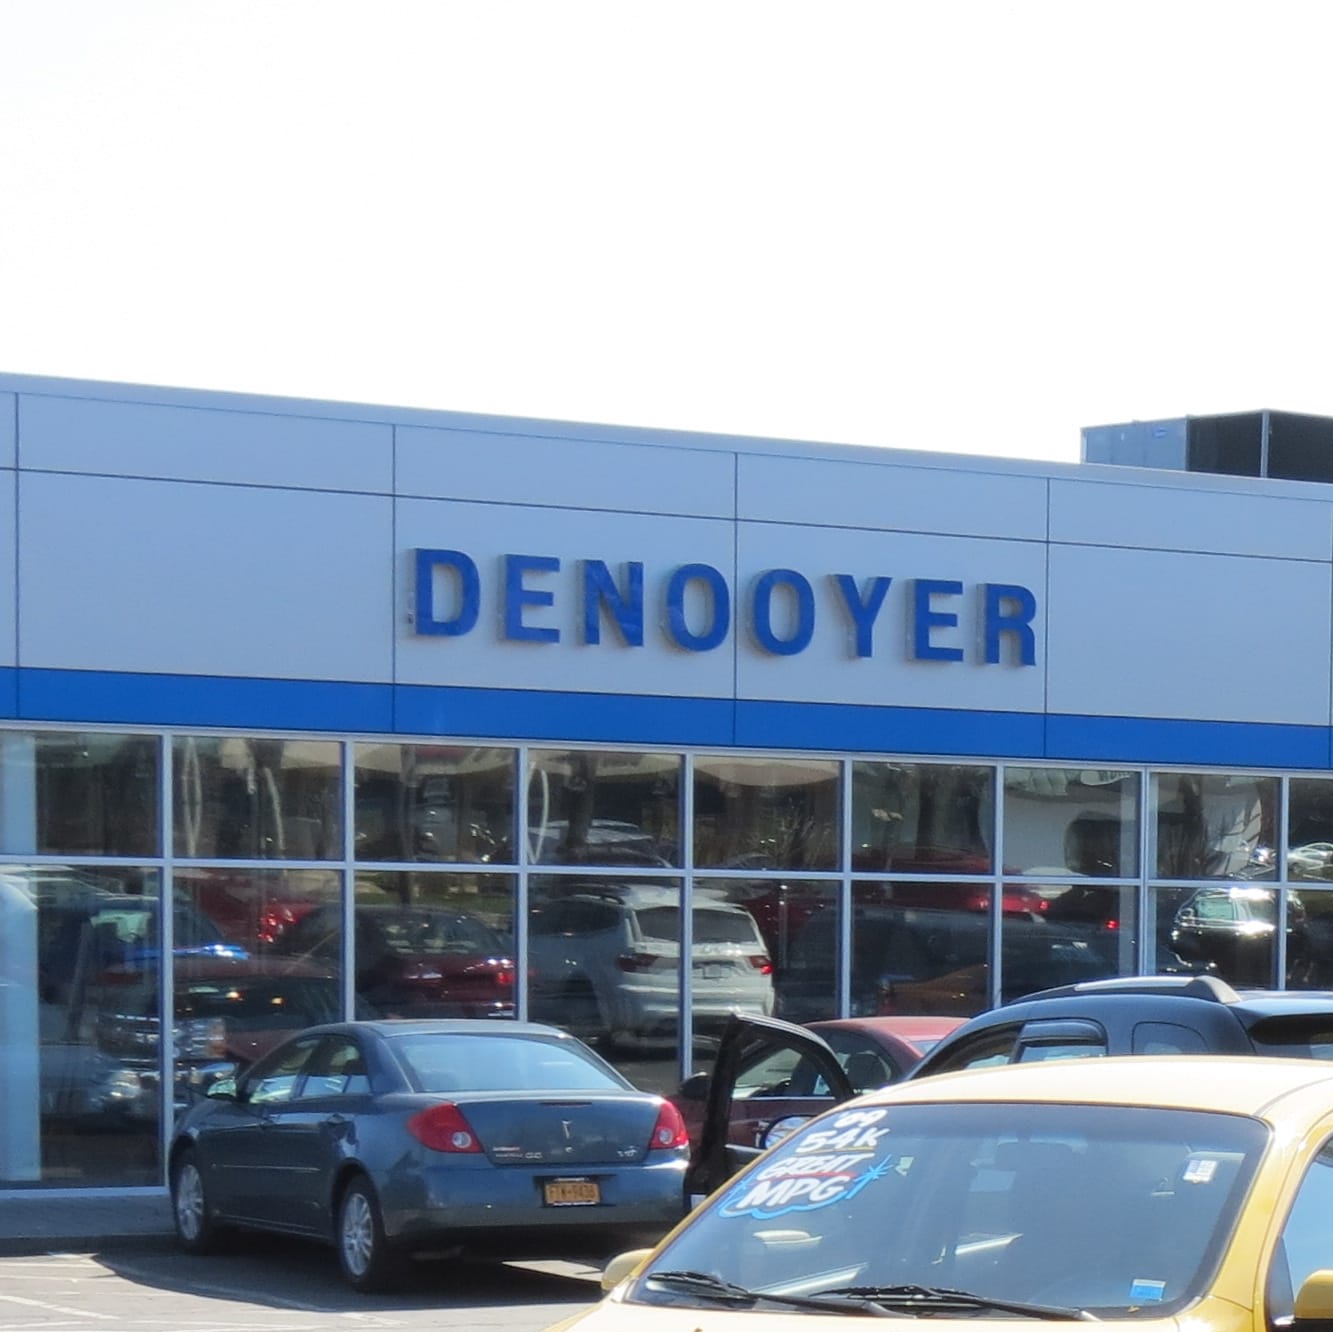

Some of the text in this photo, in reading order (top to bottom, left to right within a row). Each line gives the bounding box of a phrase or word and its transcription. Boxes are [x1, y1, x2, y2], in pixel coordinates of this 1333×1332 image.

[412, 547, 1038, 667] DENOOYER
[795, 1127, 891, 1153] 54K
[756, 1152, 876, 1182] GREAT
[735, 1175, 851, 1209] MPG
